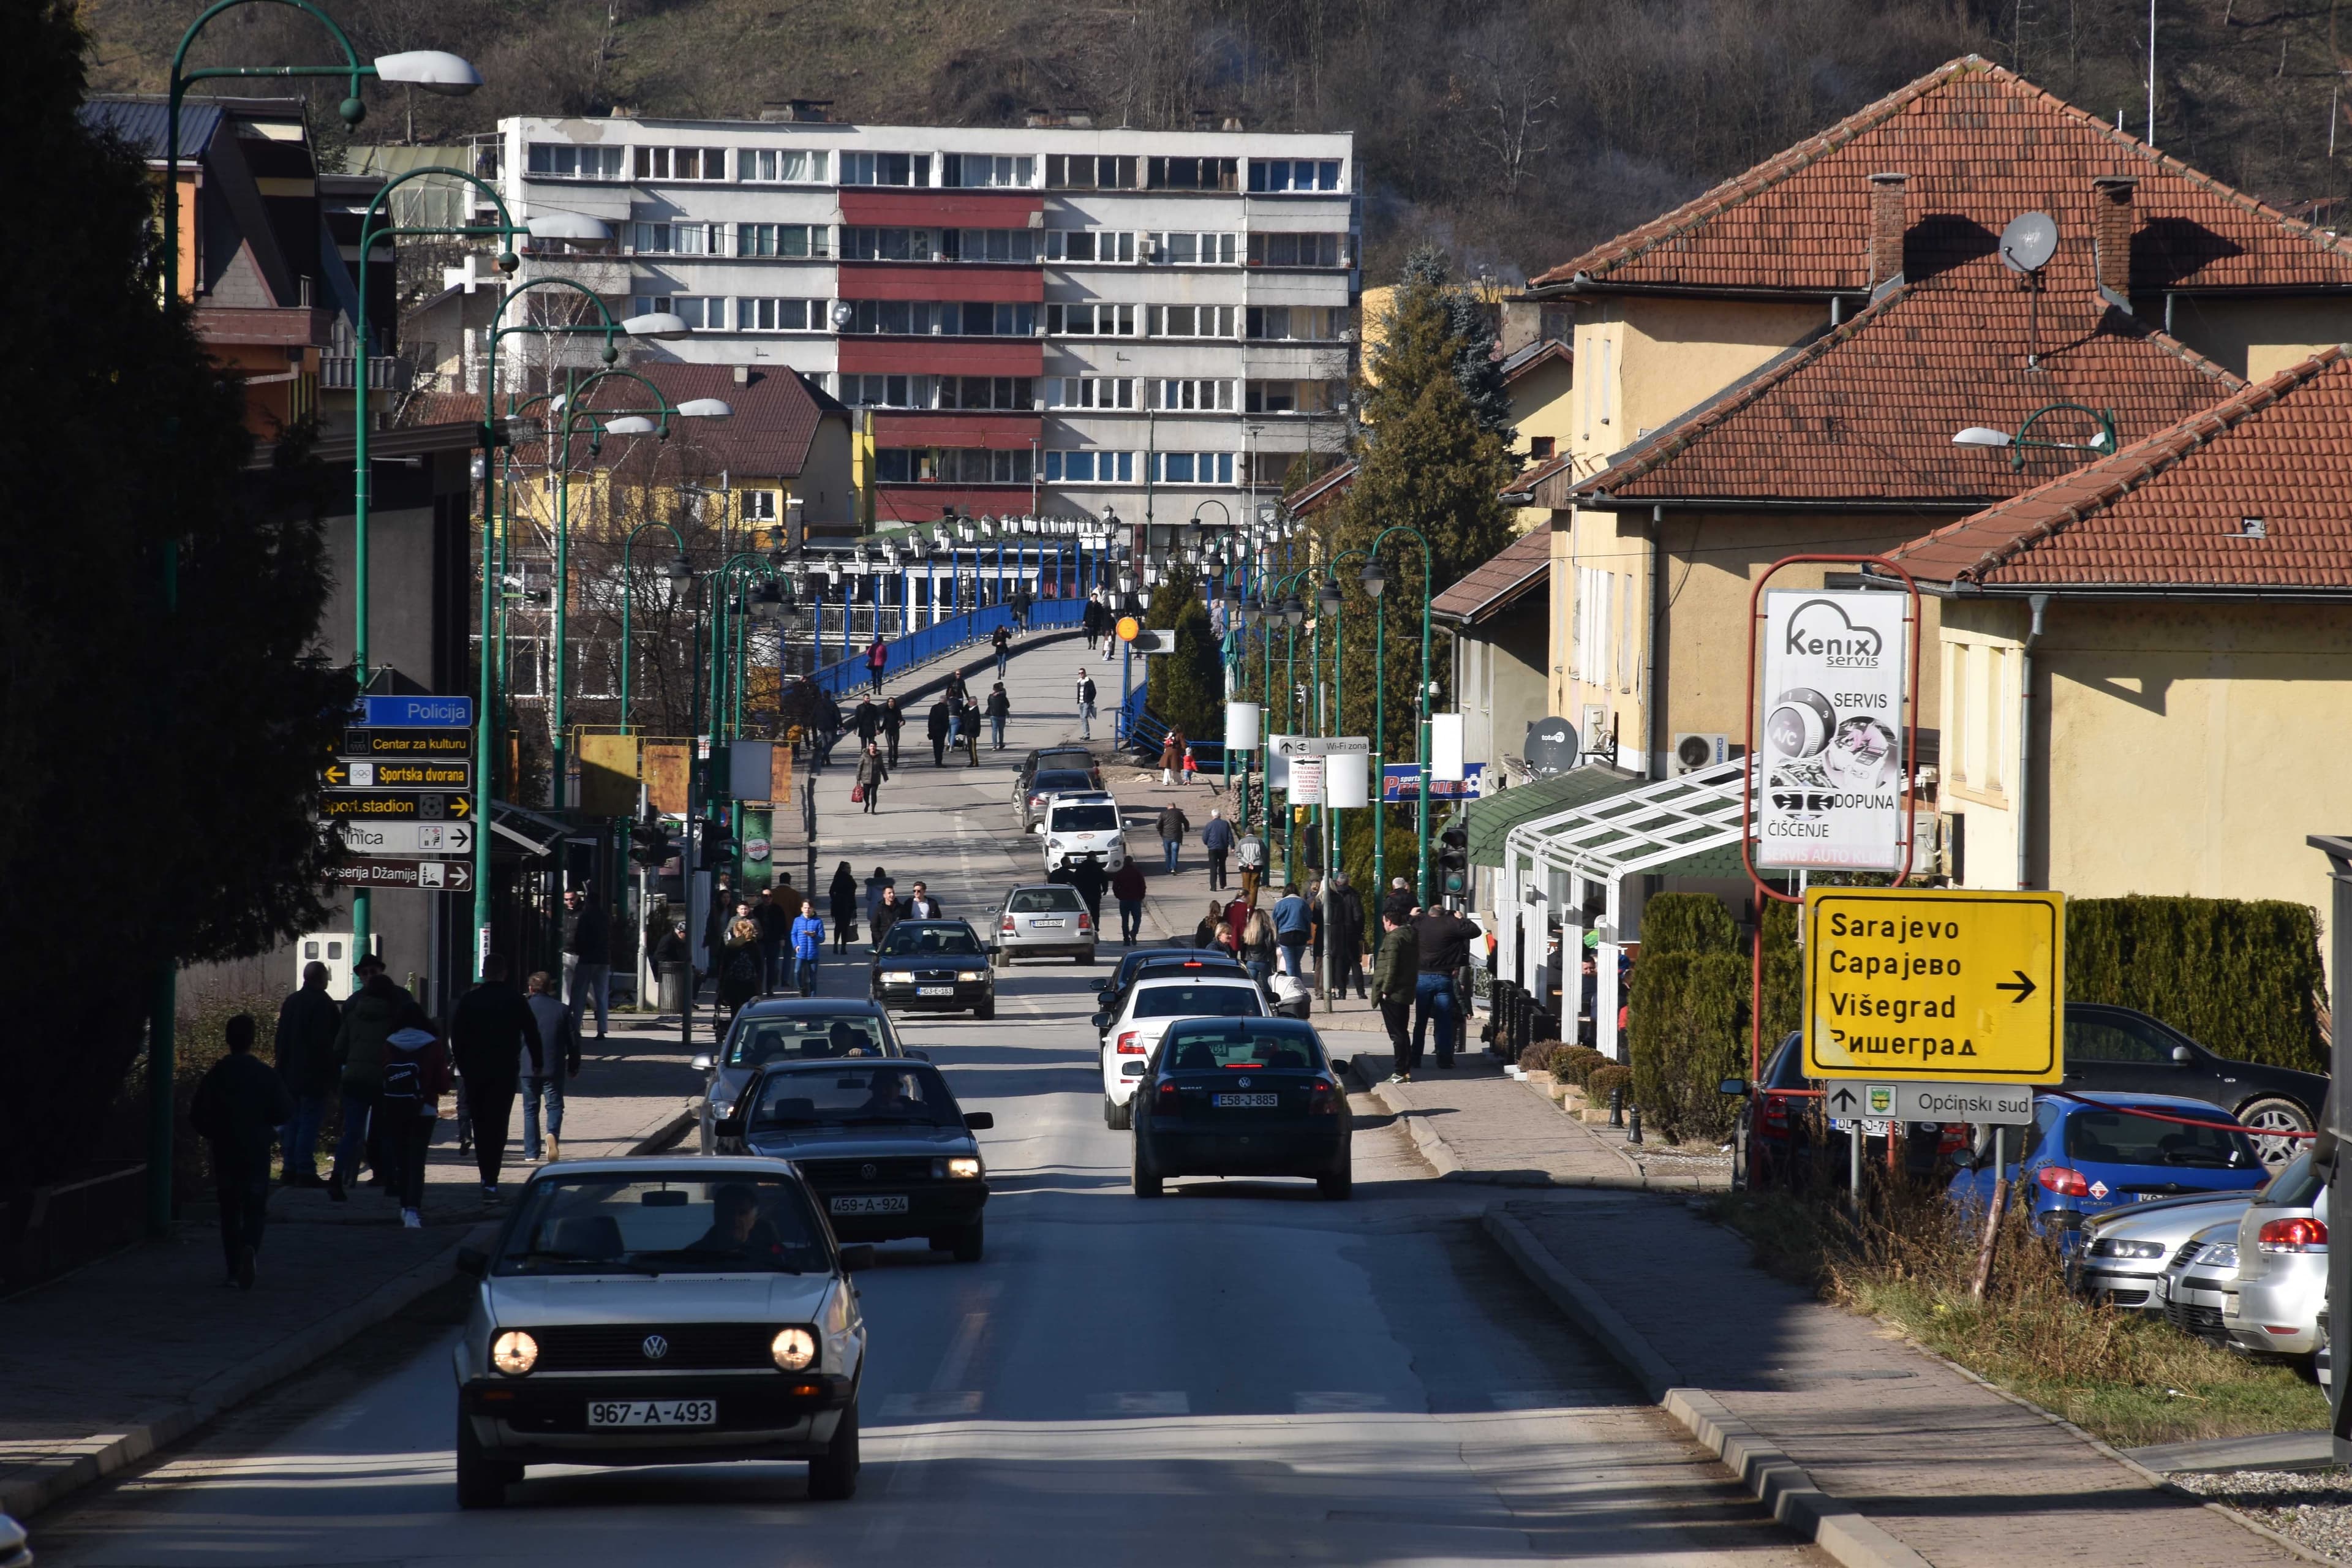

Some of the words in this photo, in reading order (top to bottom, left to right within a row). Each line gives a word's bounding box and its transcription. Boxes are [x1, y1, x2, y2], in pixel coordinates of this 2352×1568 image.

[1786, 628, 1870, 655] Kenix
[1826, 655, 1879, 666] servis
[1834, 693, 1887, 708] SERVIS
[408, 703, 466, 723] Policija
[372, 739, 410, 750] Centar
[413, 741, 426, 750] za
[429, 739, 466, 750] kulturu
[1773, 727, 1797, 745] A/C
[380, 766, 423, 784] Sportska
[426, 767, 464, 782] dvorana
[1834, 794, 1894, 809] DOPUNA
[329, 828, 384, 845] lnica
[1768, 820, 1829, 837] ČIŠĆENJE
[1764, 847, 1809, 861] SERVIS
[1811, 848, 1849, 862] AUTO
[372, 865, 417, 883] Džamija
[1831, 913, 1959, 944] Sarajevo
[1830, 950, 1961, 981] Сарајево
[1830, 993, 1956, 1023] Višegrad
[388, 1070, 412, 1082] adidas
[1220, 1095, 1276, 1106] E58-J-885
[1918, 1093, 1992, 1114] Općinski
[1998, 1096, 2029, 1113] sud
[834, 1198, 906, 1211] 459-A-924
[592, 1402, 712, 1423] 967-A-493
